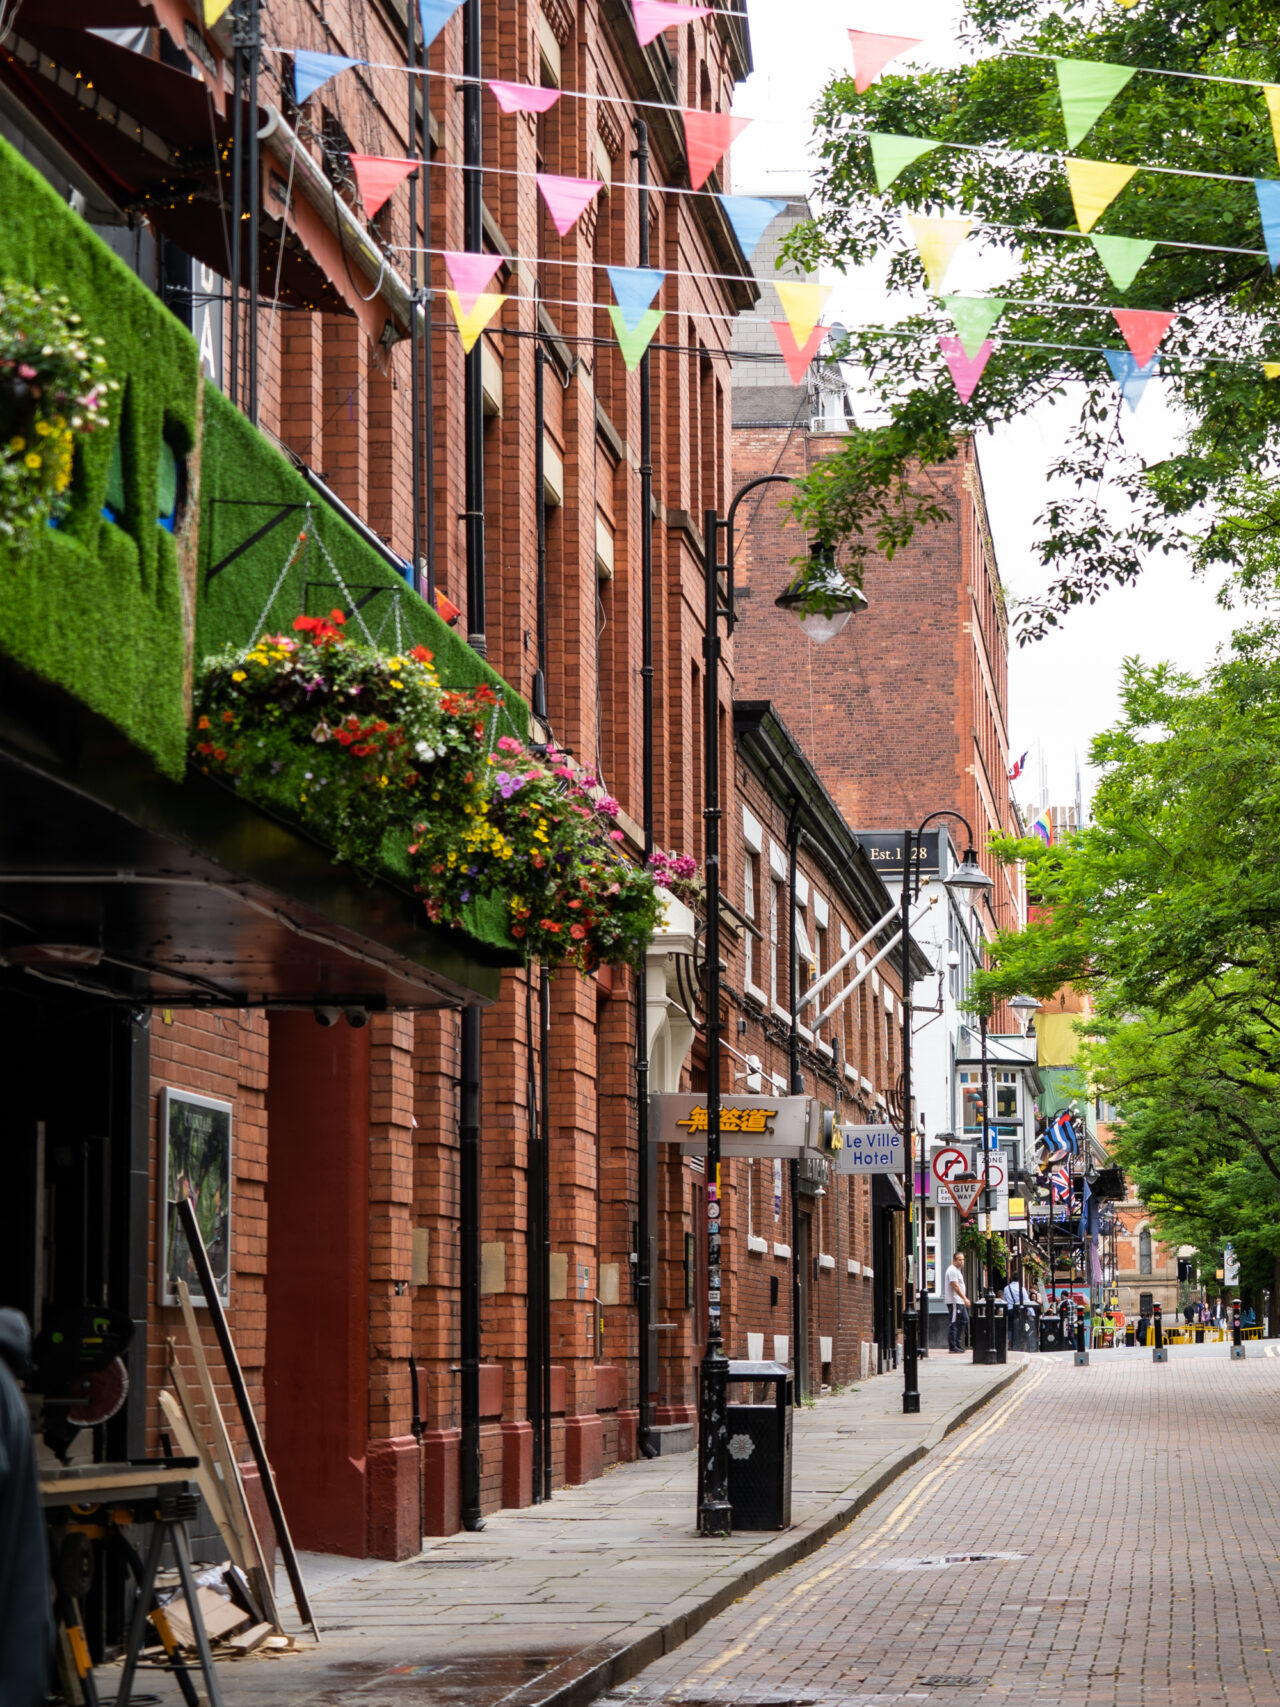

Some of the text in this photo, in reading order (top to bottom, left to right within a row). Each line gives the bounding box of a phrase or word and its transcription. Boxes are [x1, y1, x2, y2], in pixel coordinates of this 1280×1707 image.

[870, 847, 928, 860] Est.128
[846, 1133, 900, 1148] Le Villé
[853, 1150, 893, 1165] Hotel
[953, 1184, 976, 1193] GIVE
